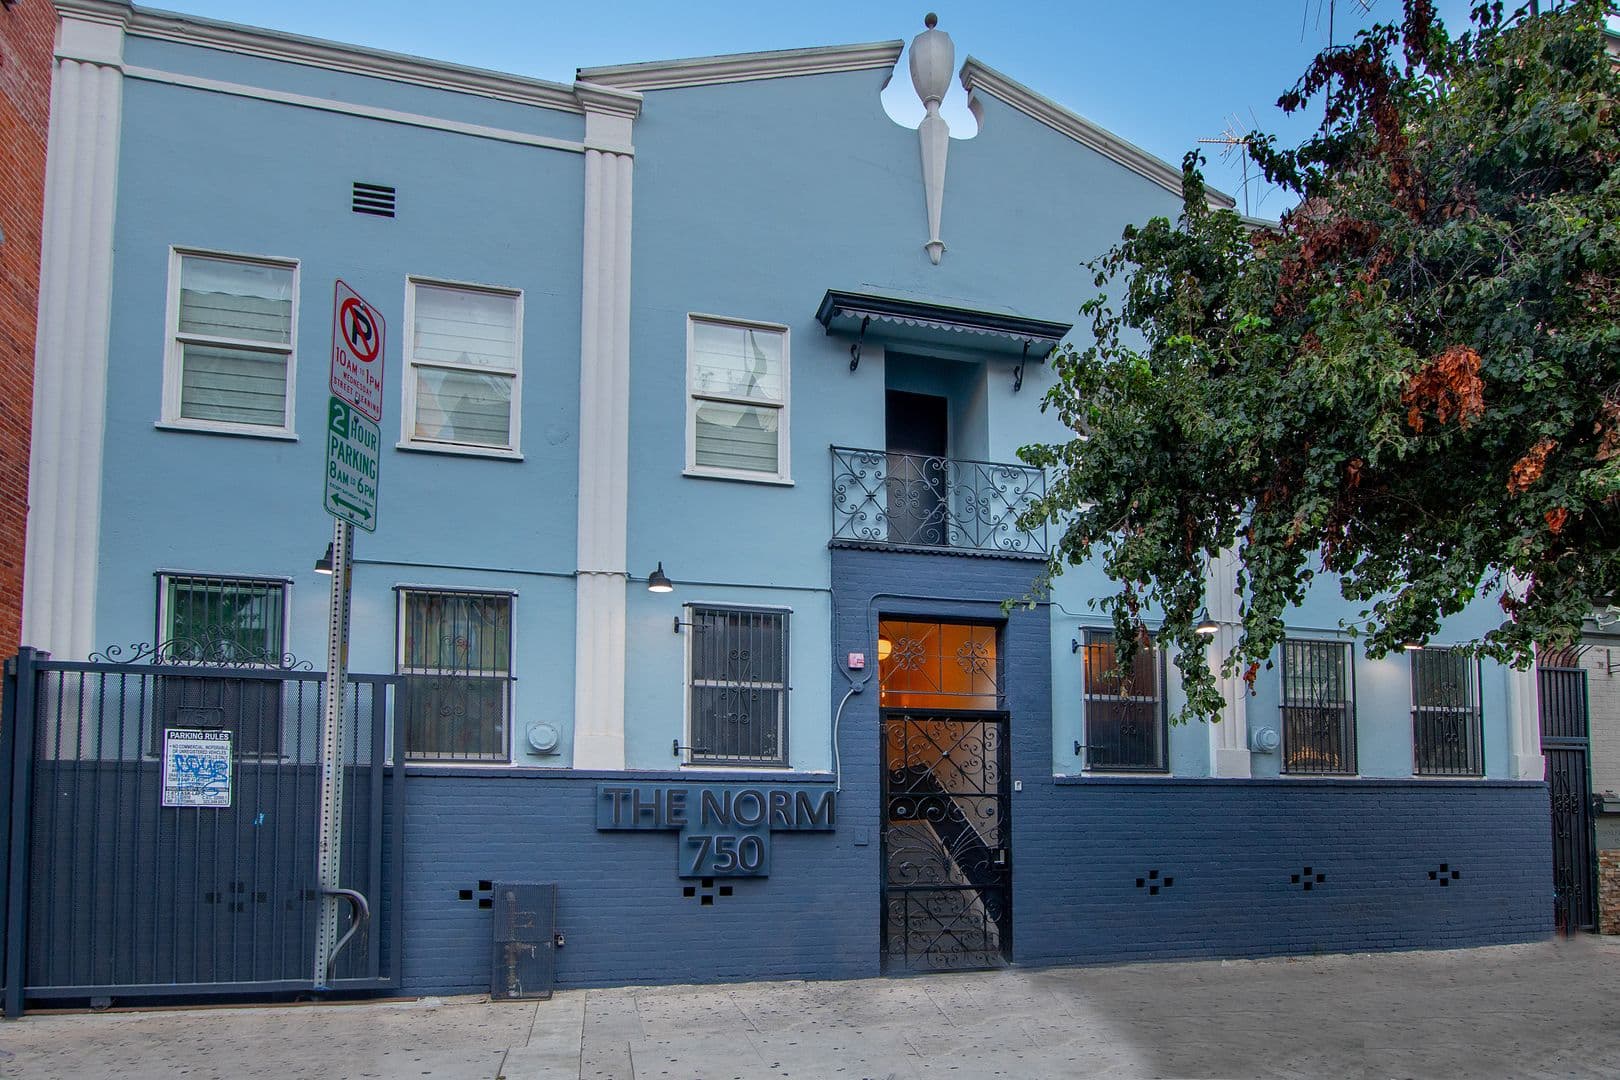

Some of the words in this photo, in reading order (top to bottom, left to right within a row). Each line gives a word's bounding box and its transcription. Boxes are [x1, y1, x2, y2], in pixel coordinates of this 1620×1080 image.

[333, 376, 353, 394] STREET
[336, 346, 358, 376] 10AM
[366, 369, 380, 392] 1PM
[343, 371, 372, 397] WEDNESDAY
[333, 404, 345, 432] 2
[351, 419, 376, 452] HOUR
[331, 435, 376, 480] PARKING
[329, 460, 349, 486] 8AM
[357, 477, 375, 500] 6PM
[169, 731, 204, 740] PARKING
[204, 732, 229, 741] RULES
[602, 787, 688, 825] THE
[701, 788, 835, 826] NORM
[687, 835, 765, 872] 750
